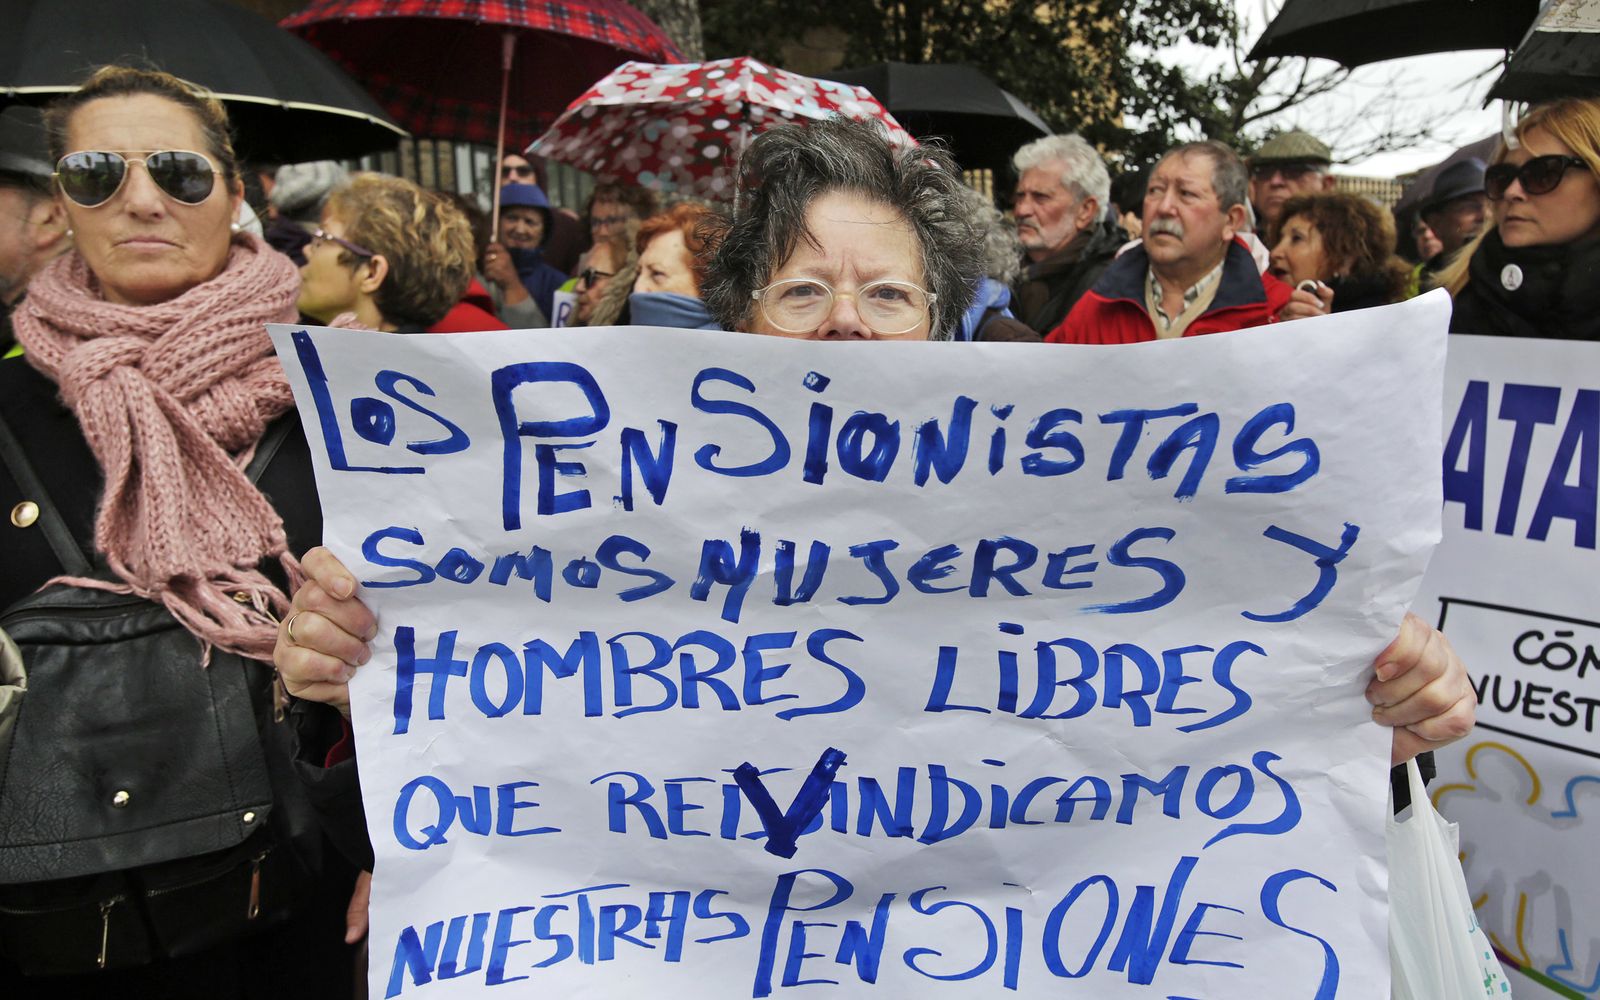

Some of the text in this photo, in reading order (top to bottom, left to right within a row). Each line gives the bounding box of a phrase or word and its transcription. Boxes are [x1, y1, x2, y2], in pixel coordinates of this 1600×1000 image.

[690, 526, 1187, 624] MUJERES
[1241, 521, 1360, 623] Y
[393, 626, 867, 735] HOMBRES
[393, 775, 562, 851] QUE
[384, 883, 752, 999] NUESTRAS
